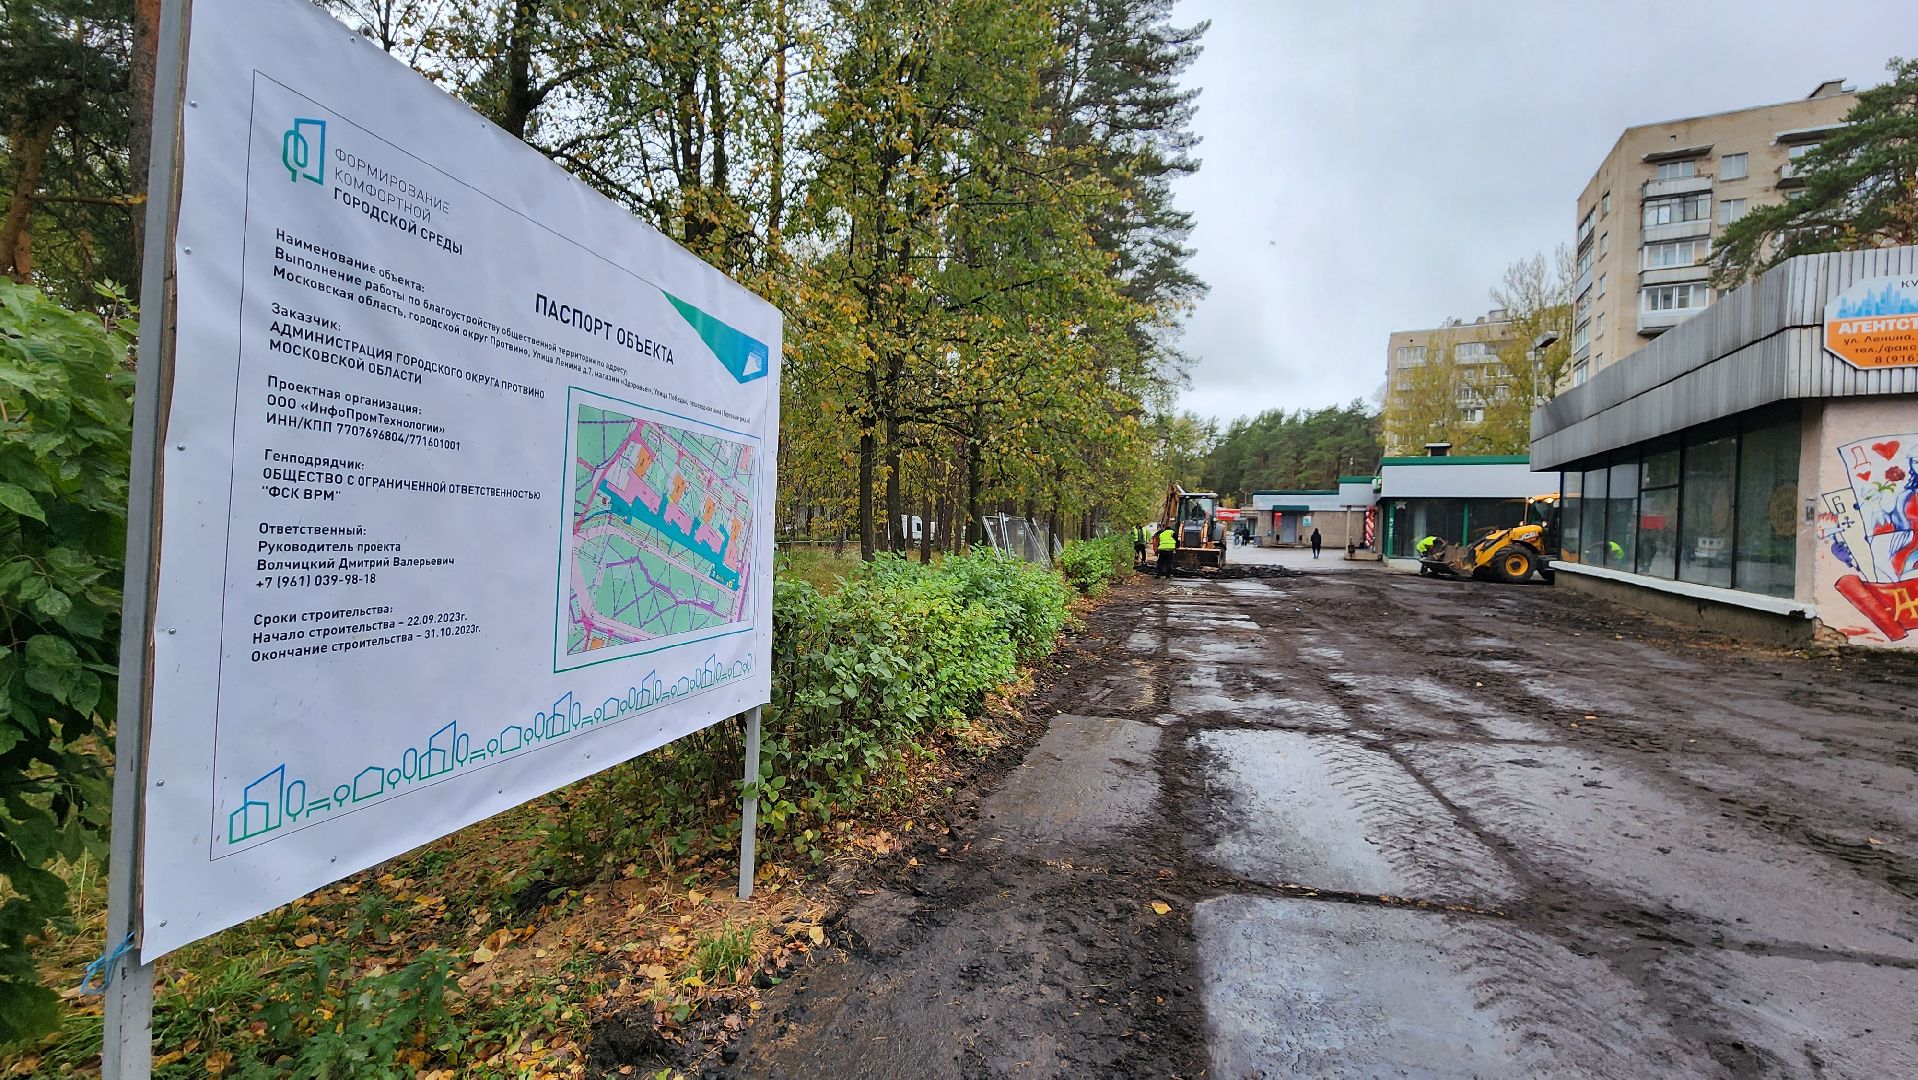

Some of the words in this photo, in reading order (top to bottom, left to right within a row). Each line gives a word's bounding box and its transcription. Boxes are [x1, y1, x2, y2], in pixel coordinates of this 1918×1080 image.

[335, 148, 450, 214] ФОРМИРОВАНИЕ
[335, 167, 432, 223] КОМФОРТНОЙ
[333, 187, 417, 235] ГОРОДСКОЙ
[420, 228, 463, 255] СРЕДЫ
[276, 228, 376, 273] Наименование
[378, 268, 425, 293] объекта:
[271, 302, 341, 331] Заказчик:
[273, 265, 354, 301] Московская
[357, 295, 407, 319] область,
[408, 310, 460, 334] городской
[462, 328, 488, 343] округ
[491, 335, 531, 357] Протвино,
[532, 349, 554, 364] Улица
[555, 357, 581, 372] Ленина
[275, 246, 362, 286] Выполнение
[365, 280, 405, 301] работы
[408, 295, 421, 306] по
[423, 299, 500, 334] благоустройству
[501, 328, 557, 352] общественной
[535, 293, 612, 340] ПАСПОРТ
[617, 327, 675, 365] ОБЪЕКТА
[269, 321, 393, 361] АДМИНИСТРАЦИЯ
[396, 352, 463, 379] ГОРОДСКОГО
[465, 372, 500, 388] ОКРУГА
[501, 380, 545, 399] ПРОТВИНО
[269, 339, 365, 371] МОСКОВСКОЙ
[368, 362, 422, 384] ОБЛАСТИ
[267, 375, 341, 400] Проектная
[344, 393, 422, 415] организация:
[267, 394, 297, 409] ООО
[300, 401, 445, 434] «ИнфоПромТехнологии»
[266, 411, 332, 433] ИНН/КПП
[336, 422, 461, 451] 7707696804/771601001
[264, 448, 365, 470] Генподрядчик:
[261, 485, 300, 500] "ФСК
[303, 488, 341, 501] ВРМ"
[262, 467, 343, 484] ОБЩЕСТВО
[347, 475, 355, 486] С
[357, 475, 446, 494] ОГРАНИЧЕННОЙ
[448, 483, 541, 500] ОТВЕТСТВЕННОСТЬЮ
[1832, 495, 1846, 514] 6
[258, 540, 354, 555] Руководитель
[357, 543, 401, 555] проекта
[259, 522, 367, 536] Ответственный:
[256, 576, 273, 589] +7
[277, 574, 311, 589] (961)
[314, 573, 377, 587] 039-98-18
[257, 558, 335, 571] Волчицкий
[338, 556, 390, 570] Дмитрий
[393, 556, 455, 568] Валерьевич
[252, 629, 305, 644] Начало
[308, 620, 395, 639] строительства
[407, 611, 468, 627] 22.09.2023г.
[253, 612, 297, 627] Сроки
[301, 605, 394, 623] строительства:
[251, 643, 328, 662] Окончание
[331, 632, 414, 652] строительства
[424, 623, 481, 639] 31.10.2023г.
